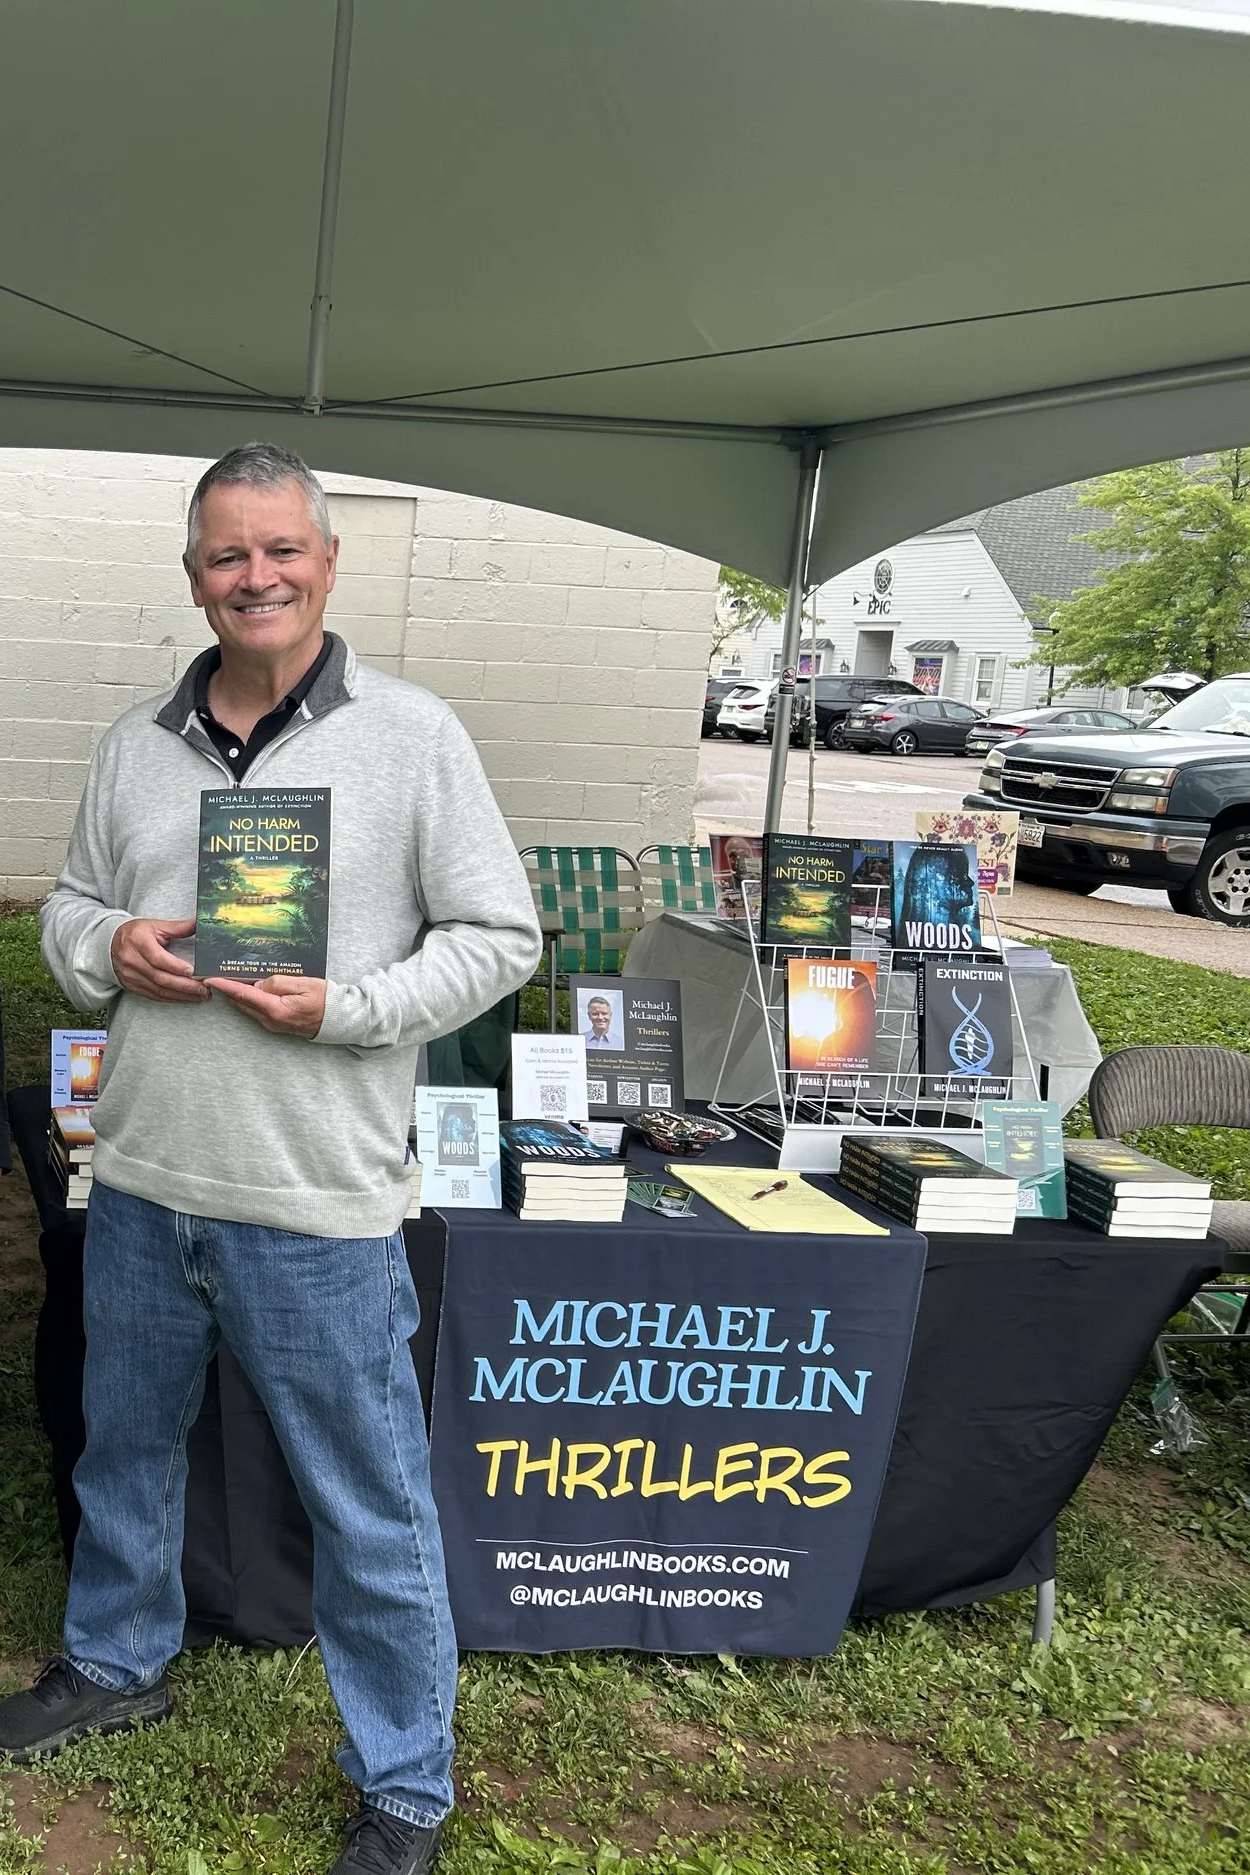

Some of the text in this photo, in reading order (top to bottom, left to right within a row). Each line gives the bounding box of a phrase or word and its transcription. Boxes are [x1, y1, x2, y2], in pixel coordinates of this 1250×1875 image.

[868, 600, 891, 614] EPIC
[252, 795, 258, 803] J.
[230, 818, 300, 830] NO HARM
[210, 834, 319, 853] INTENDED
[788, 856, 834, 867] NO HARM
[776, 867, 846, 883] INTENDED
[905, 921, 972, 950] WOODS
[809, 966, 855, 990] FUGUE
[936, 969, 1003, 981] EXTINCTION
[632, 1000, 673, 1012] Michael J.
[629, 1011, 677, 1022] McLaughlin
[637, 1027, 669, 1036] Thrillers
[80, 1047, 100, 1056] FUGUE
[442, 1141, 475, 1155] WOODS
[515, 1145, 601, 1158] WOODS
[508, 1298, 834, 1356] MICHAEL J.
[468, 1356, 872, 1416] MCLAUGHLIN
[476, 1437, 852, 1508] THRILLERS
[495, 1550, 790, 1579] MCLAUGHLINBOOKS.COM
[510, 1584, 764, 1609] @MCLAUGHLINBOOKS
